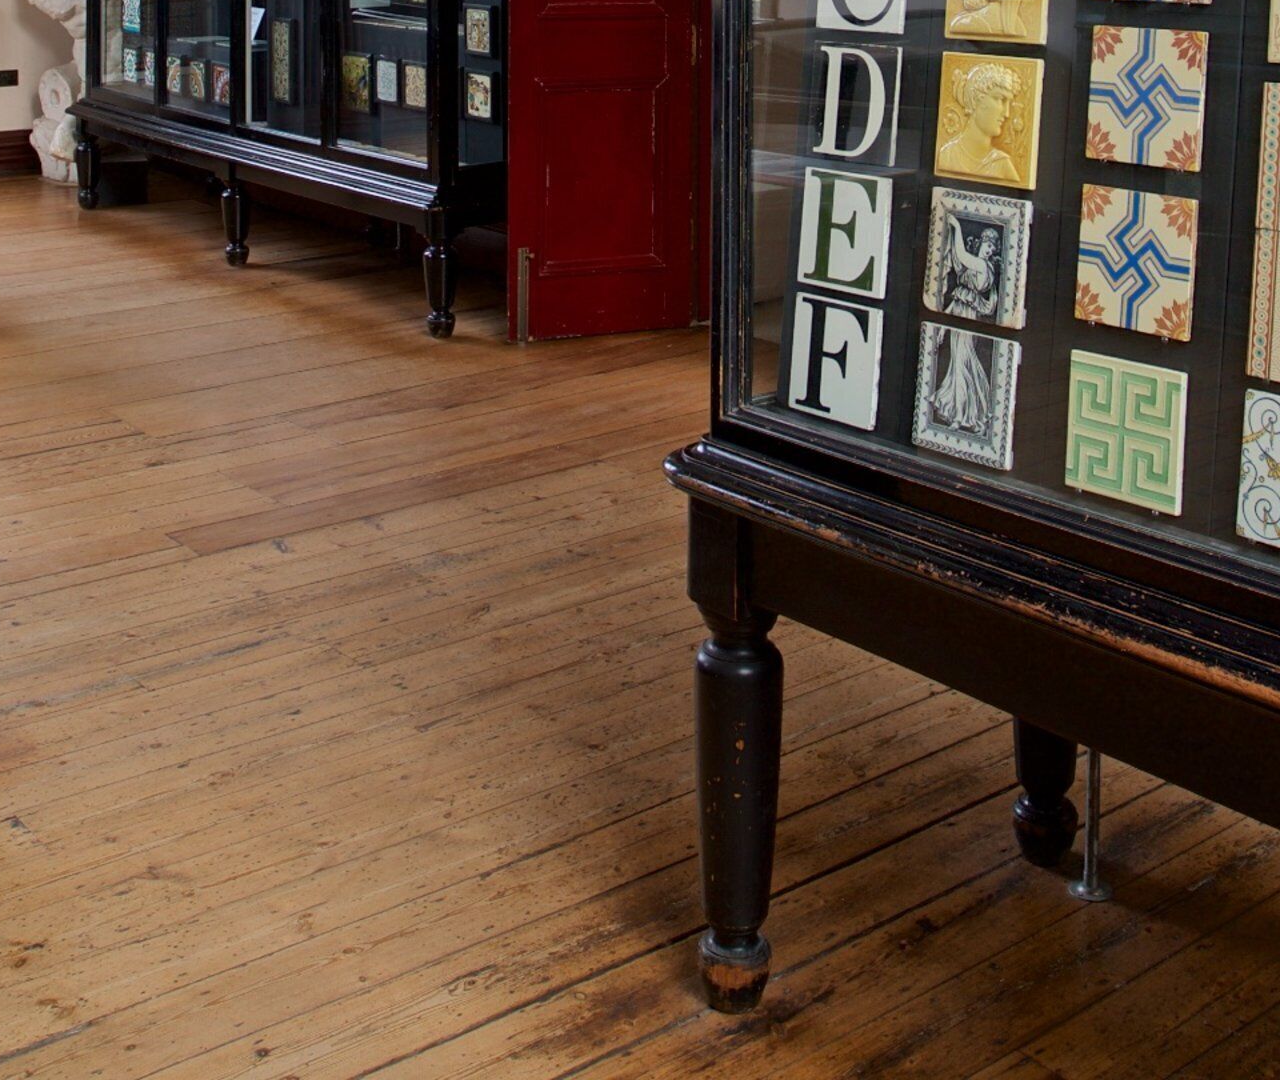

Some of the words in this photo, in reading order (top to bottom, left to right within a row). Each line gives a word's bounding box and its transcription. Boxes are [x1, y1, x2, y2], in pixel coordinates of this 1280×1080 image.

[813, 45, 886, 157] D
[804, 169, 878, 291] E
[795, 297, 870, 413] F
